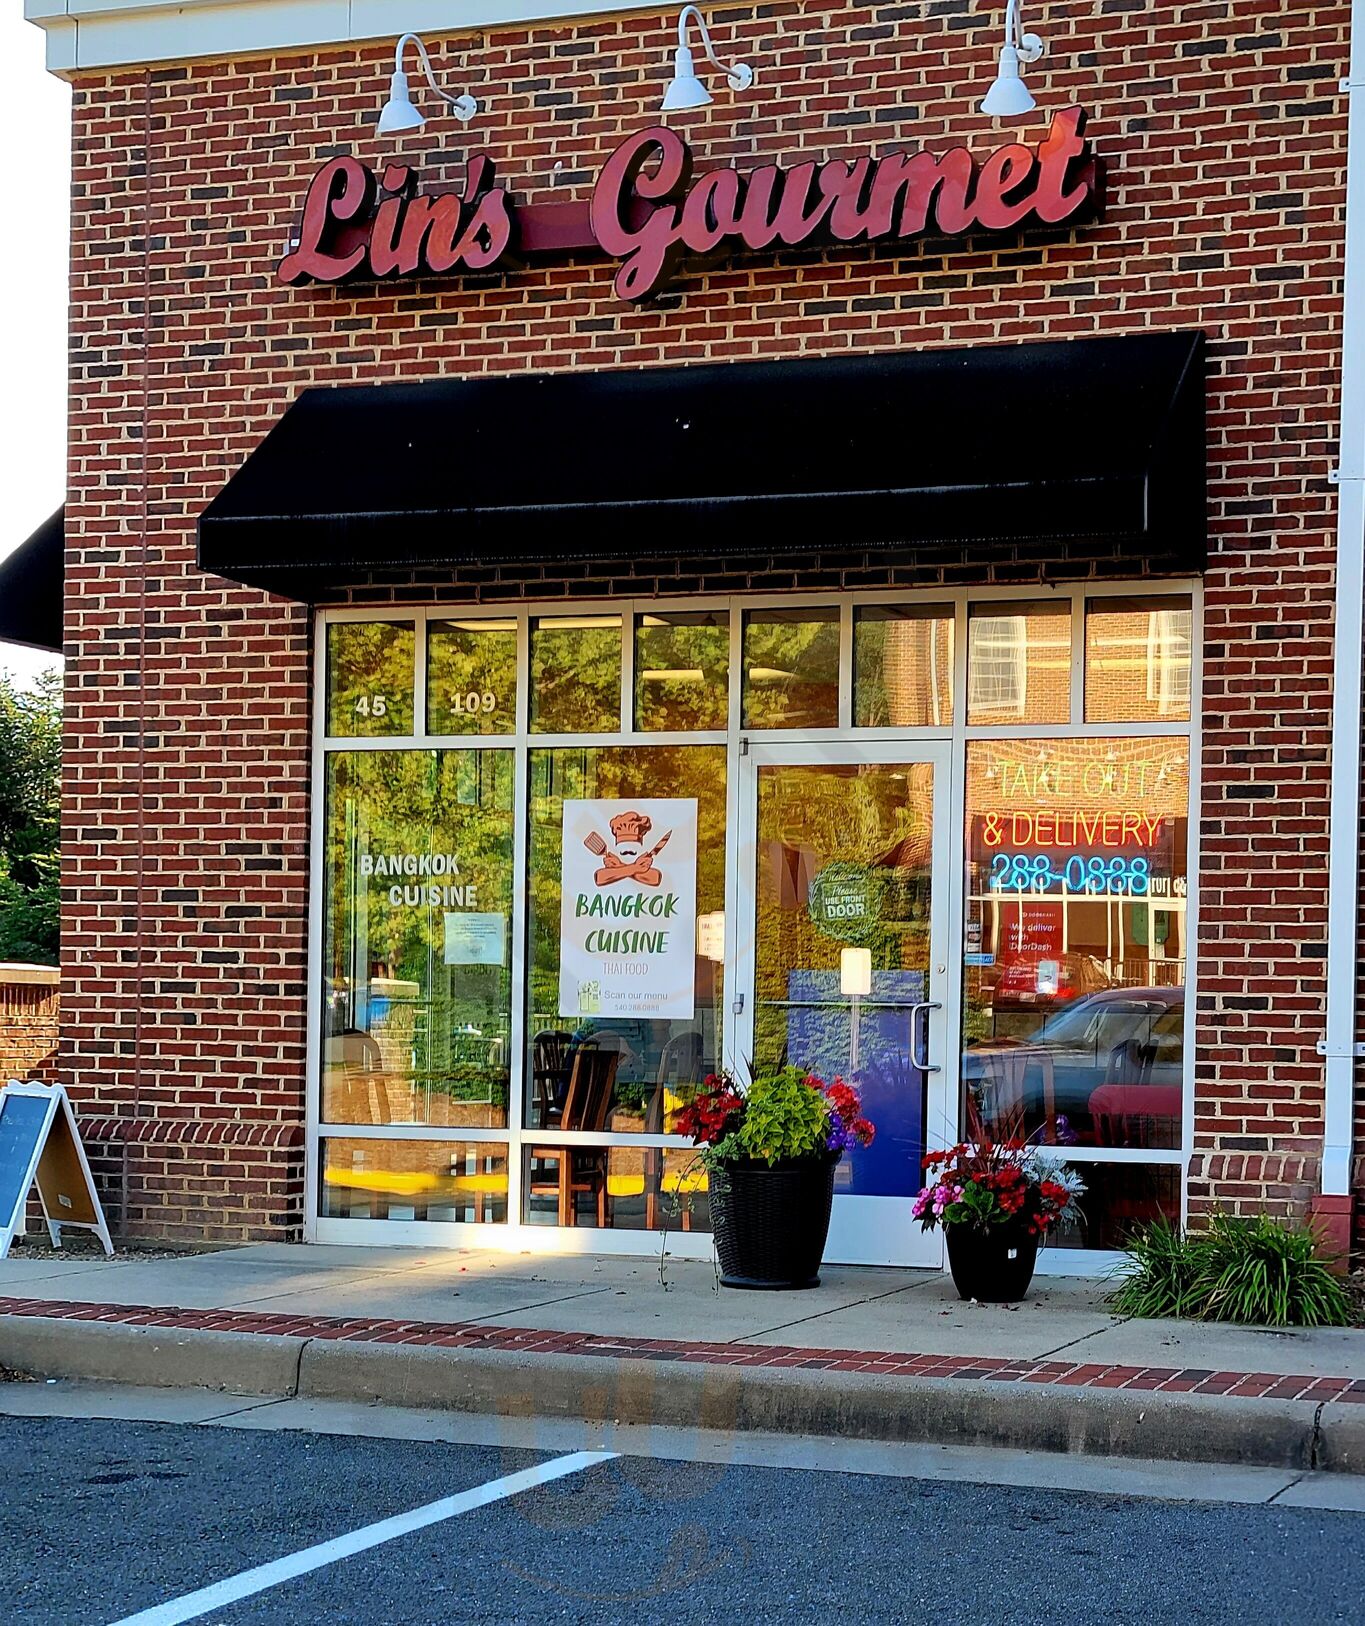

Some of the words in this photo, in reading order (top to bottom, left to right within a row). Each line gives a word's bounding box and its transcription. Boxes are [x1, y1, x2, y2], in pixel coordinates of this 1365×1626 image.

[277, 153, 513, 285] Lin's
[590, 105, 1091, 300] Gourmet
[355, 695, 386, 717] 45
[450, 691, 496, 714] 109
[998, 761, 1072, 797] TAKE
[1083, 760, 1151, 797] OUT
[983, 811, 1003, 846] &
[1012, 810, 1163, 847] DELIVERY
[360, 854, 459, 876] BANGKOK
[991, 853, 1148, 893] 288-0888
[389, 885, 478, 907] CUISINE
[575, 893, 680, 918] BANGKOK
[841, 894, 865, 903] FRONT
[827, 903, 865, 918] DOOR
[585, 929, 670, 954] CUISINE
[603, 962, 623, 975] THAI
[625, 962, 649, 975] FOOD
[604, 991, 626, 1000] Scan
[644, 992, 668, 1001] menu
